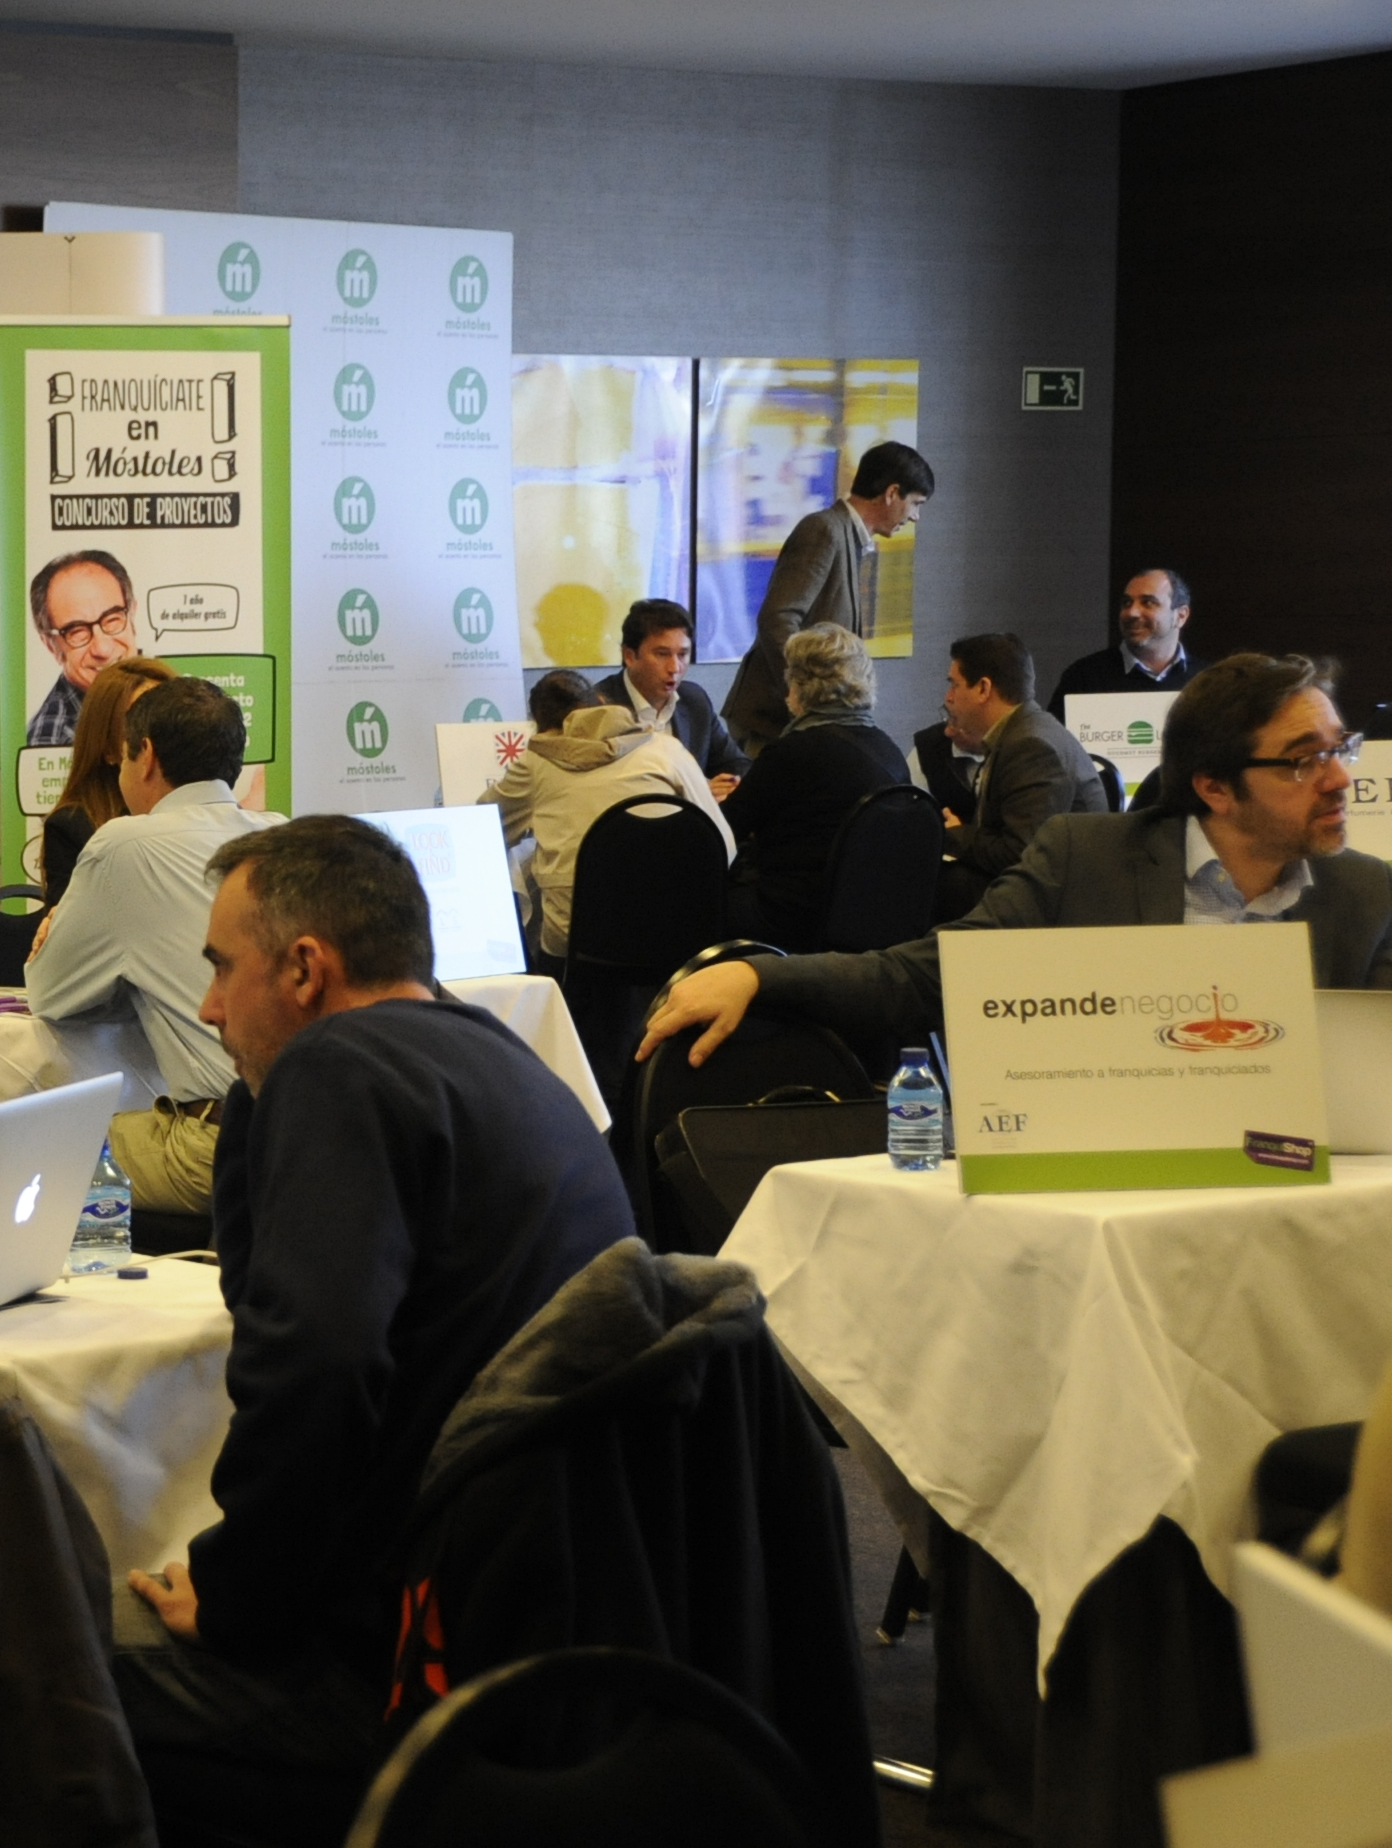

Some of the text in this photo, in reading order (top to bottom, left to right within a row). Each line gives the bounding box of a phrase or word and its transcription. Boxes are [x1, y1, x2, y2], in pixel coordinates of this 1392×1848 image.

[332, 312, 379, 326] móstoles
[81, 374, 205, 413] FRANQUÍCIATE
[127, 419, 159, 441] en
[330, 425, 378, 439] móstoles
[86, 447, 203, 478] Móstoles
[54, 496, 232, 526] CONCURSO DE PROYECTOS
[331, 538, 379, 551] móstoles
[446, 539, 493, 551] móstoles
[161, 609, 227, 622] de alquiler gratis
[336, 650, 385, 662] móstoles
[452, 649, 499, 660] móstoles
[1080, 730, 1124, 742] BURGER
[38, 757, 54, 770] En
[347, 762, 396, 775] móstoles
[1005, 1063, 1271, 1081] Asesoramiento a franquicias y franquiciados
[979, 1113, 1029, 1133] AEF
